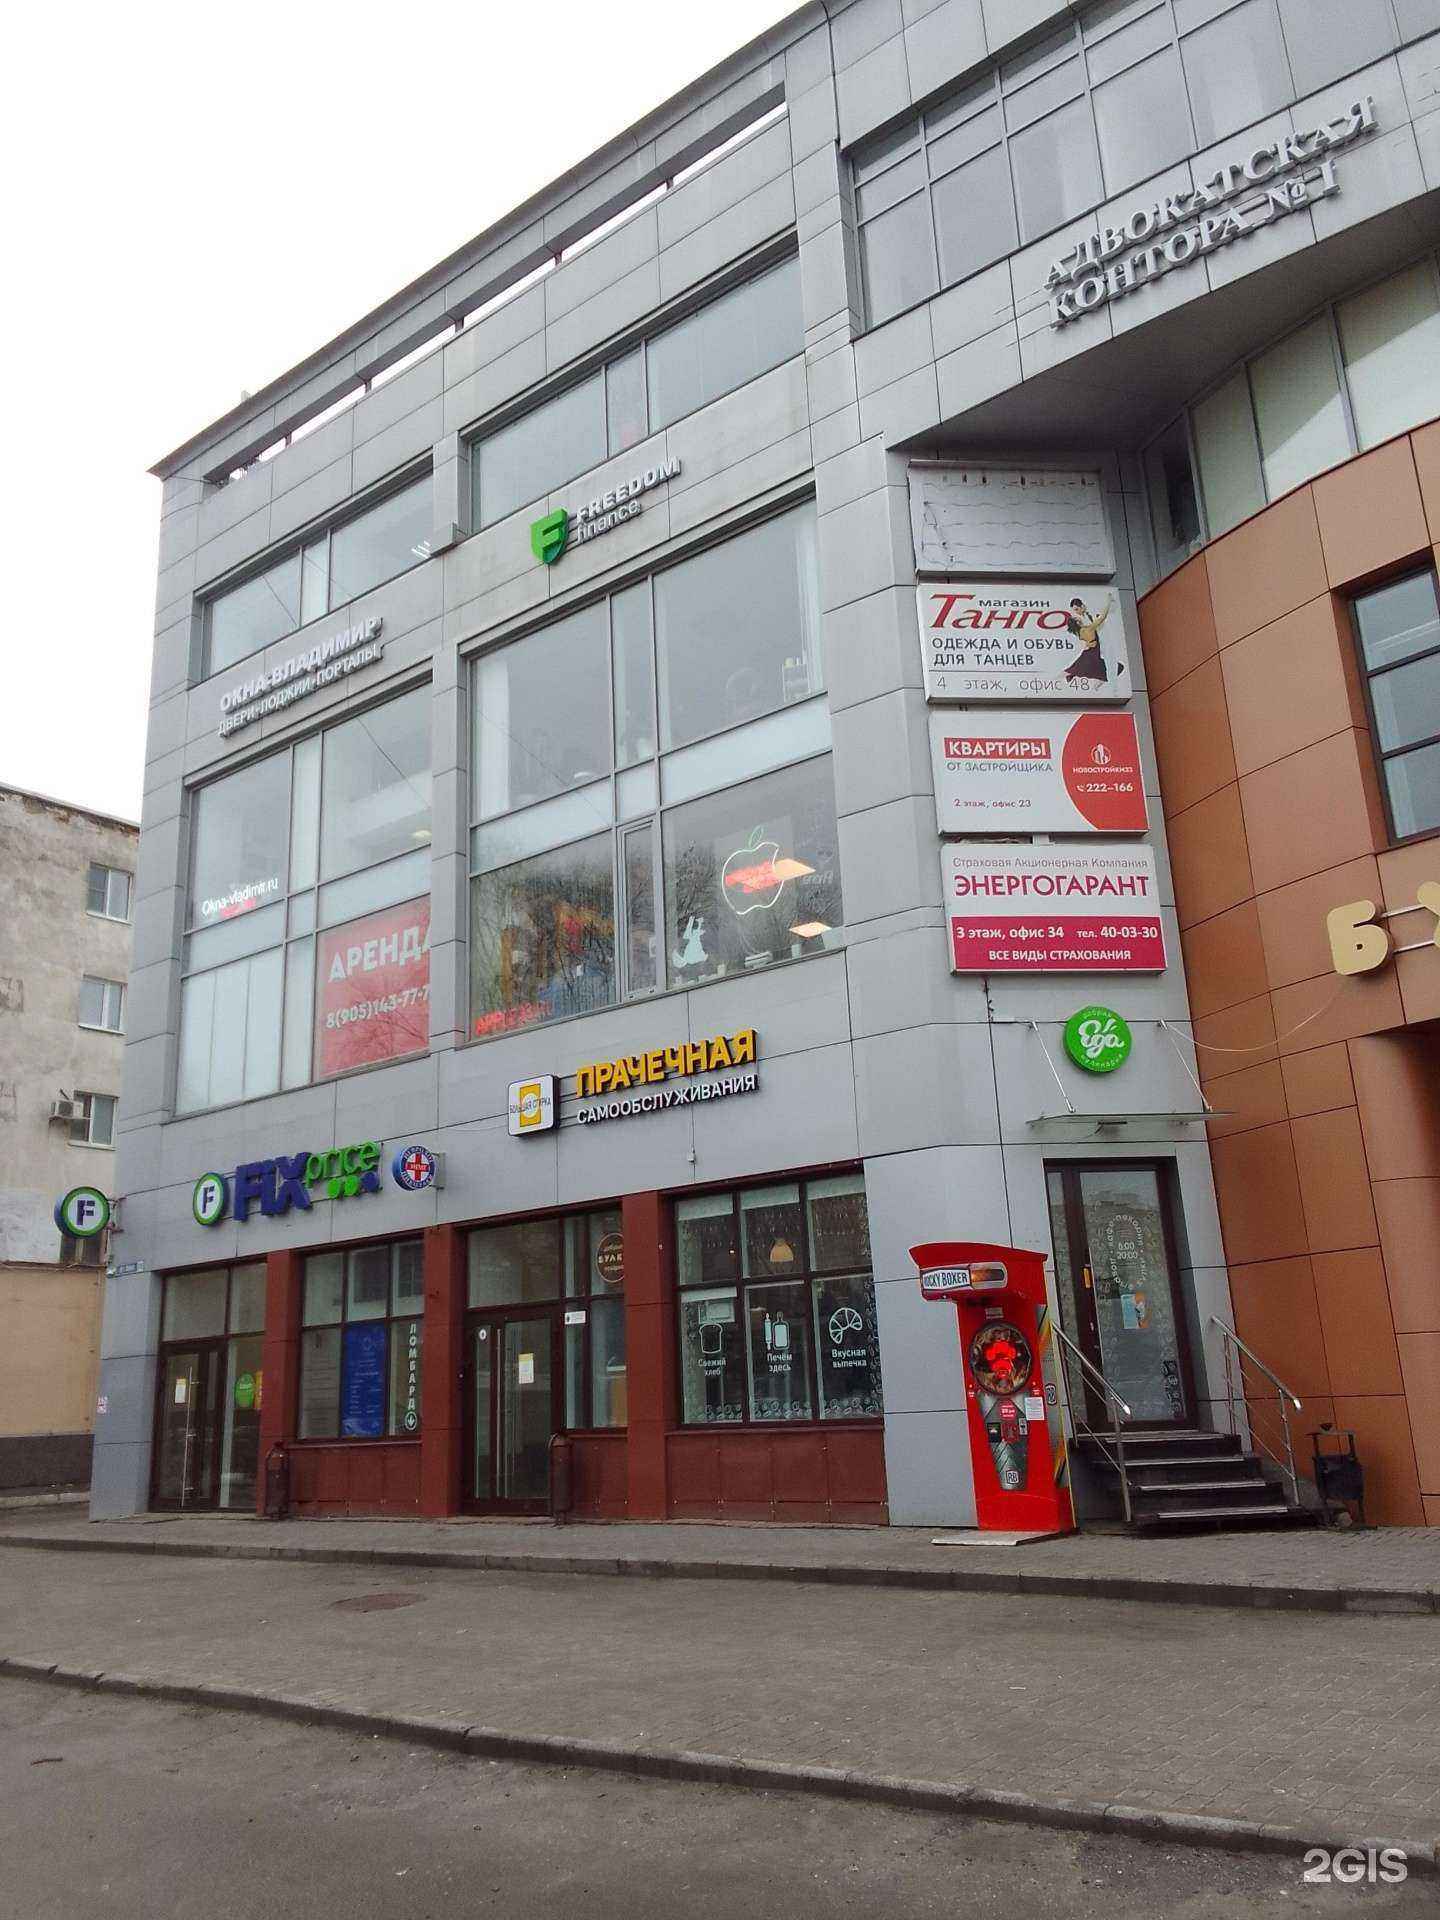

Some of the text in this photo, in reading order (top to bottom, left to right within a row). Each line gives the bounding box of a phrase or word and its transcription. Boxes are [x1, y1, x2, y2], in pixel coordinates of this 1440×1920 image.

[1044, 96, 1380, 289] АДВОКАТСКАЯ
[1050, 208, 1254, 330] КОНТОРА
[576, 456, 682, 525] FREEDOM
[577, 500, 642, 544] finance
[979, 599, 1050, 608] магазин
[929, 594, 1073, 630] Танго
[932, 638, 1074, 650] ОДЕЖДА И ОБУВЬ
[220, 616, 383, 714] ОКНА-ВЛАДИМИР
[934, 654, 1034, 666] ДЛЯ ТАНЦЕВ
[937, 676, 1090, 693] 4 этаж, офис 48
[949, 740, 1046, 757] КВАРТИРЫ
[947, 760, 1053, 774] ОТ ЗАСТРОЙЩИКА
[954, 799, 961, 807] 2
[992, 799, 1016, 809] офис
[1018, 799, 1031, 808] 23
[953, 858, 1148, 869] Страховая Акционерная Компания
[954, 875, 1149, 896] ЭНЕРГОГАРАНТ
[956, 926, 1158, 940] 3 этаж, офис 34 тел. 40-03-30
[989, 950, 1131, 961] ВСЕ ВИДЫ СТРАХОВАНИЯ
[575, 1028, 757, 1098] ПРАЧЕЧНАЯ
[577, 1074, 758, 1124] САМООБСЛУЖИВАНИЯ
[941, 1272, 968, 1286] BOXER
[832, 1349, 866, 1360] Вкусная
[408, 1323, 416, 1410] ЛОМБАРД
[704, 1367, 721, 1377] хлеб
[769, 1363, 791, 1372] здесь
